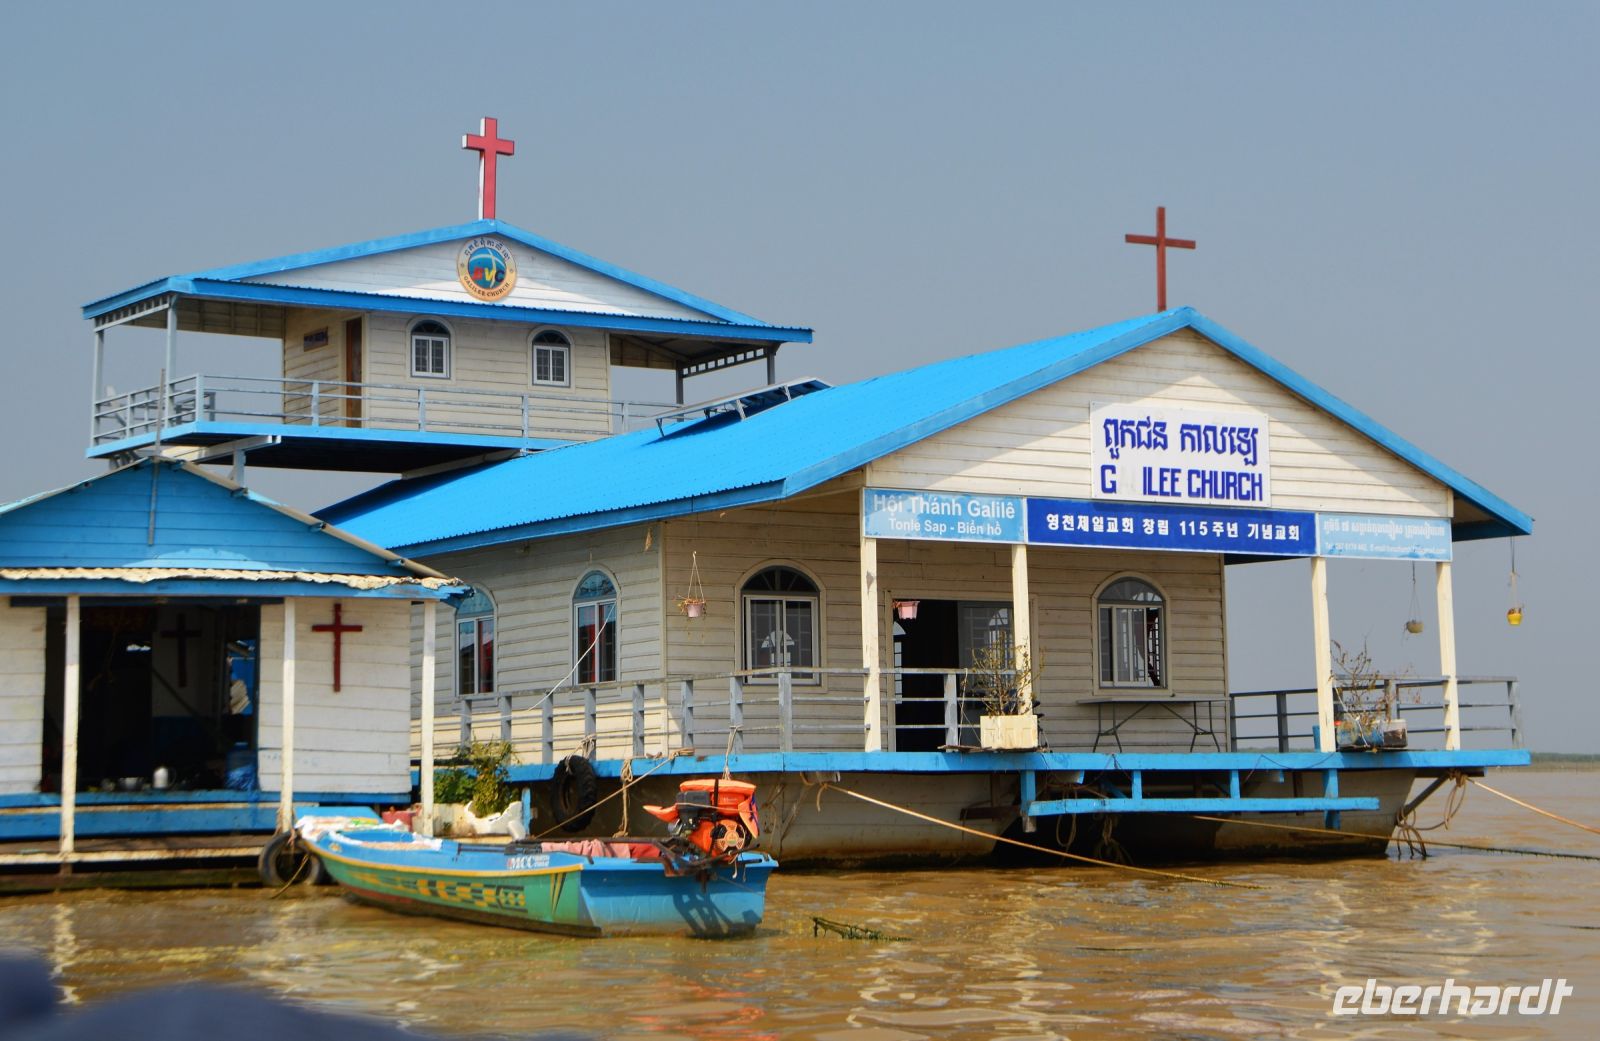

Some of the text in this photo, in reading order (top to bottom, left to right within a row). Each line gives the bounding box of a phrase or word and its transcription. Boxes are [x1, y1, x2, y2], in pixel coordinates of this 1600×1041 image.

[486, 281, 509, 296] CHURCH
[1187, 469, 1263, 501] CHURCH
[873, 494, 1015, 519] Hội Thánh Galilê
[924, 520, 947, 535] Sap
[1046, 513, 1134, 534] 영천제일교회
[1142, 518, 1169, 536] 창립
[1247, 523, 1300, 541] 기념교회
